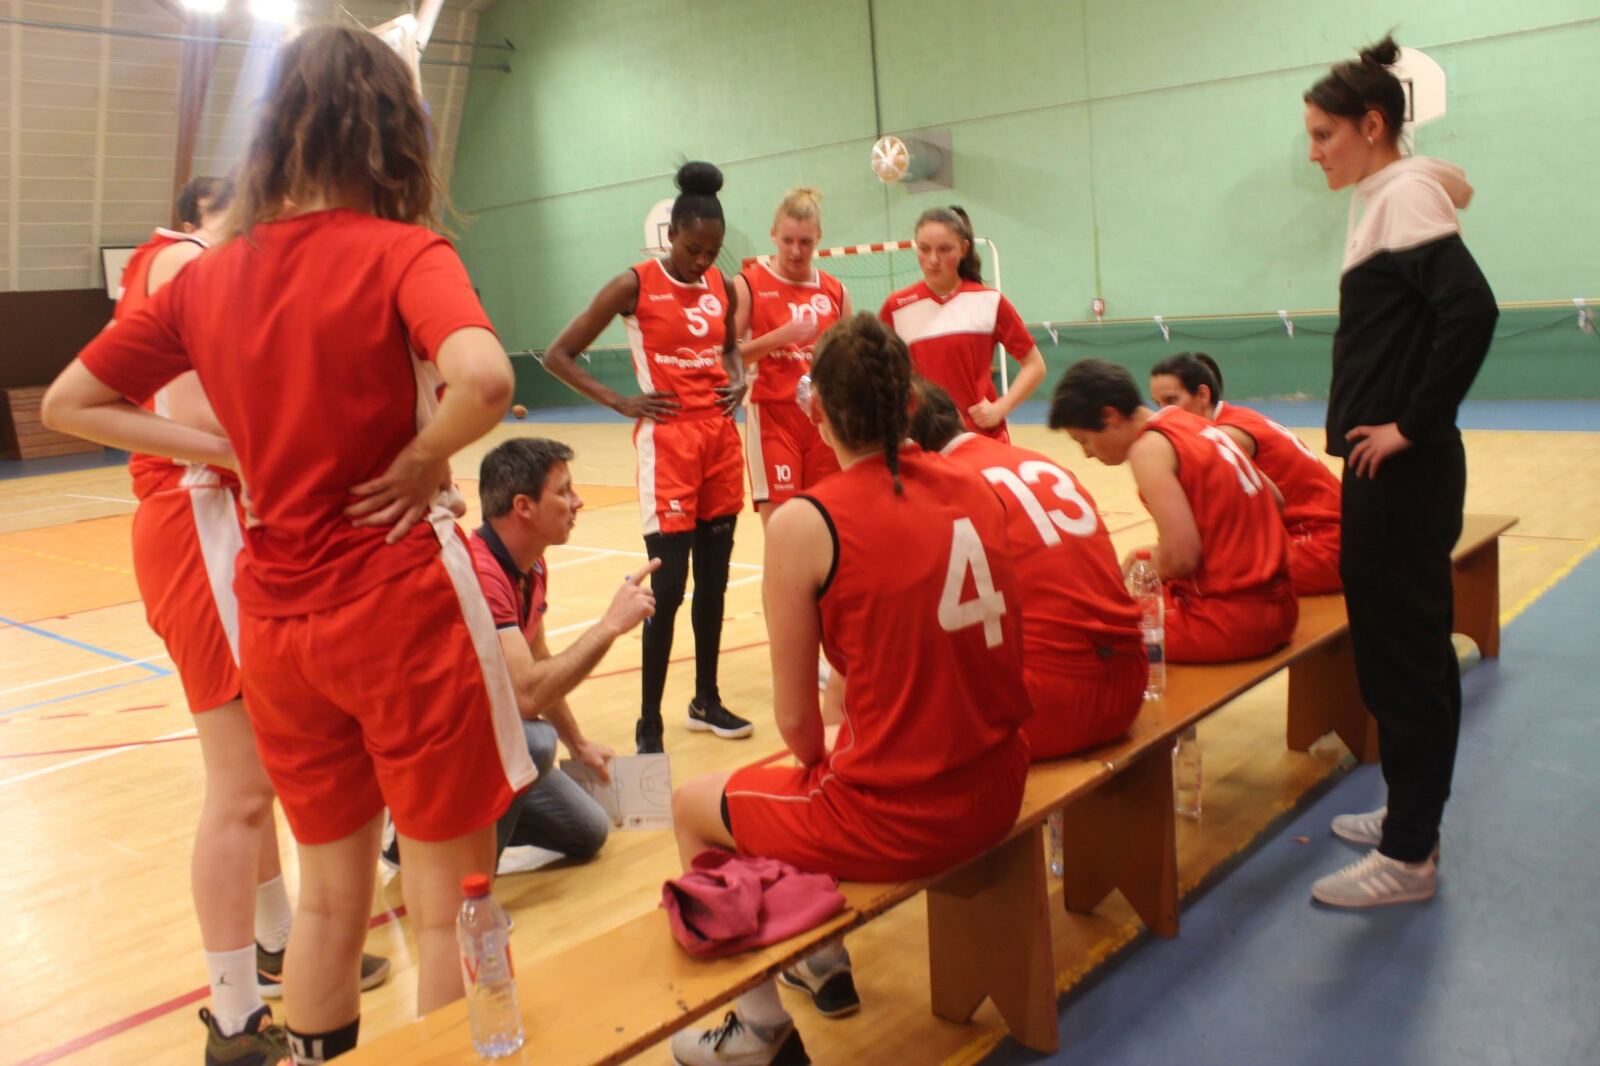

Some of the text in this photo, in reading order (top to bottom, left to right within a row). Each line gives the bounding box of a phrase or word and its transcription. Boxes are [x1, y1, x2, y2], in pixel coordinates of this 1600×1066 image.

[682, 306, 709, 337] 5
[787, 302, 818, 326] 10
[774, 464, 791, 482] 10
[981, 460, 1098, 547] 13
[937, 517, 1007, 649] 4
